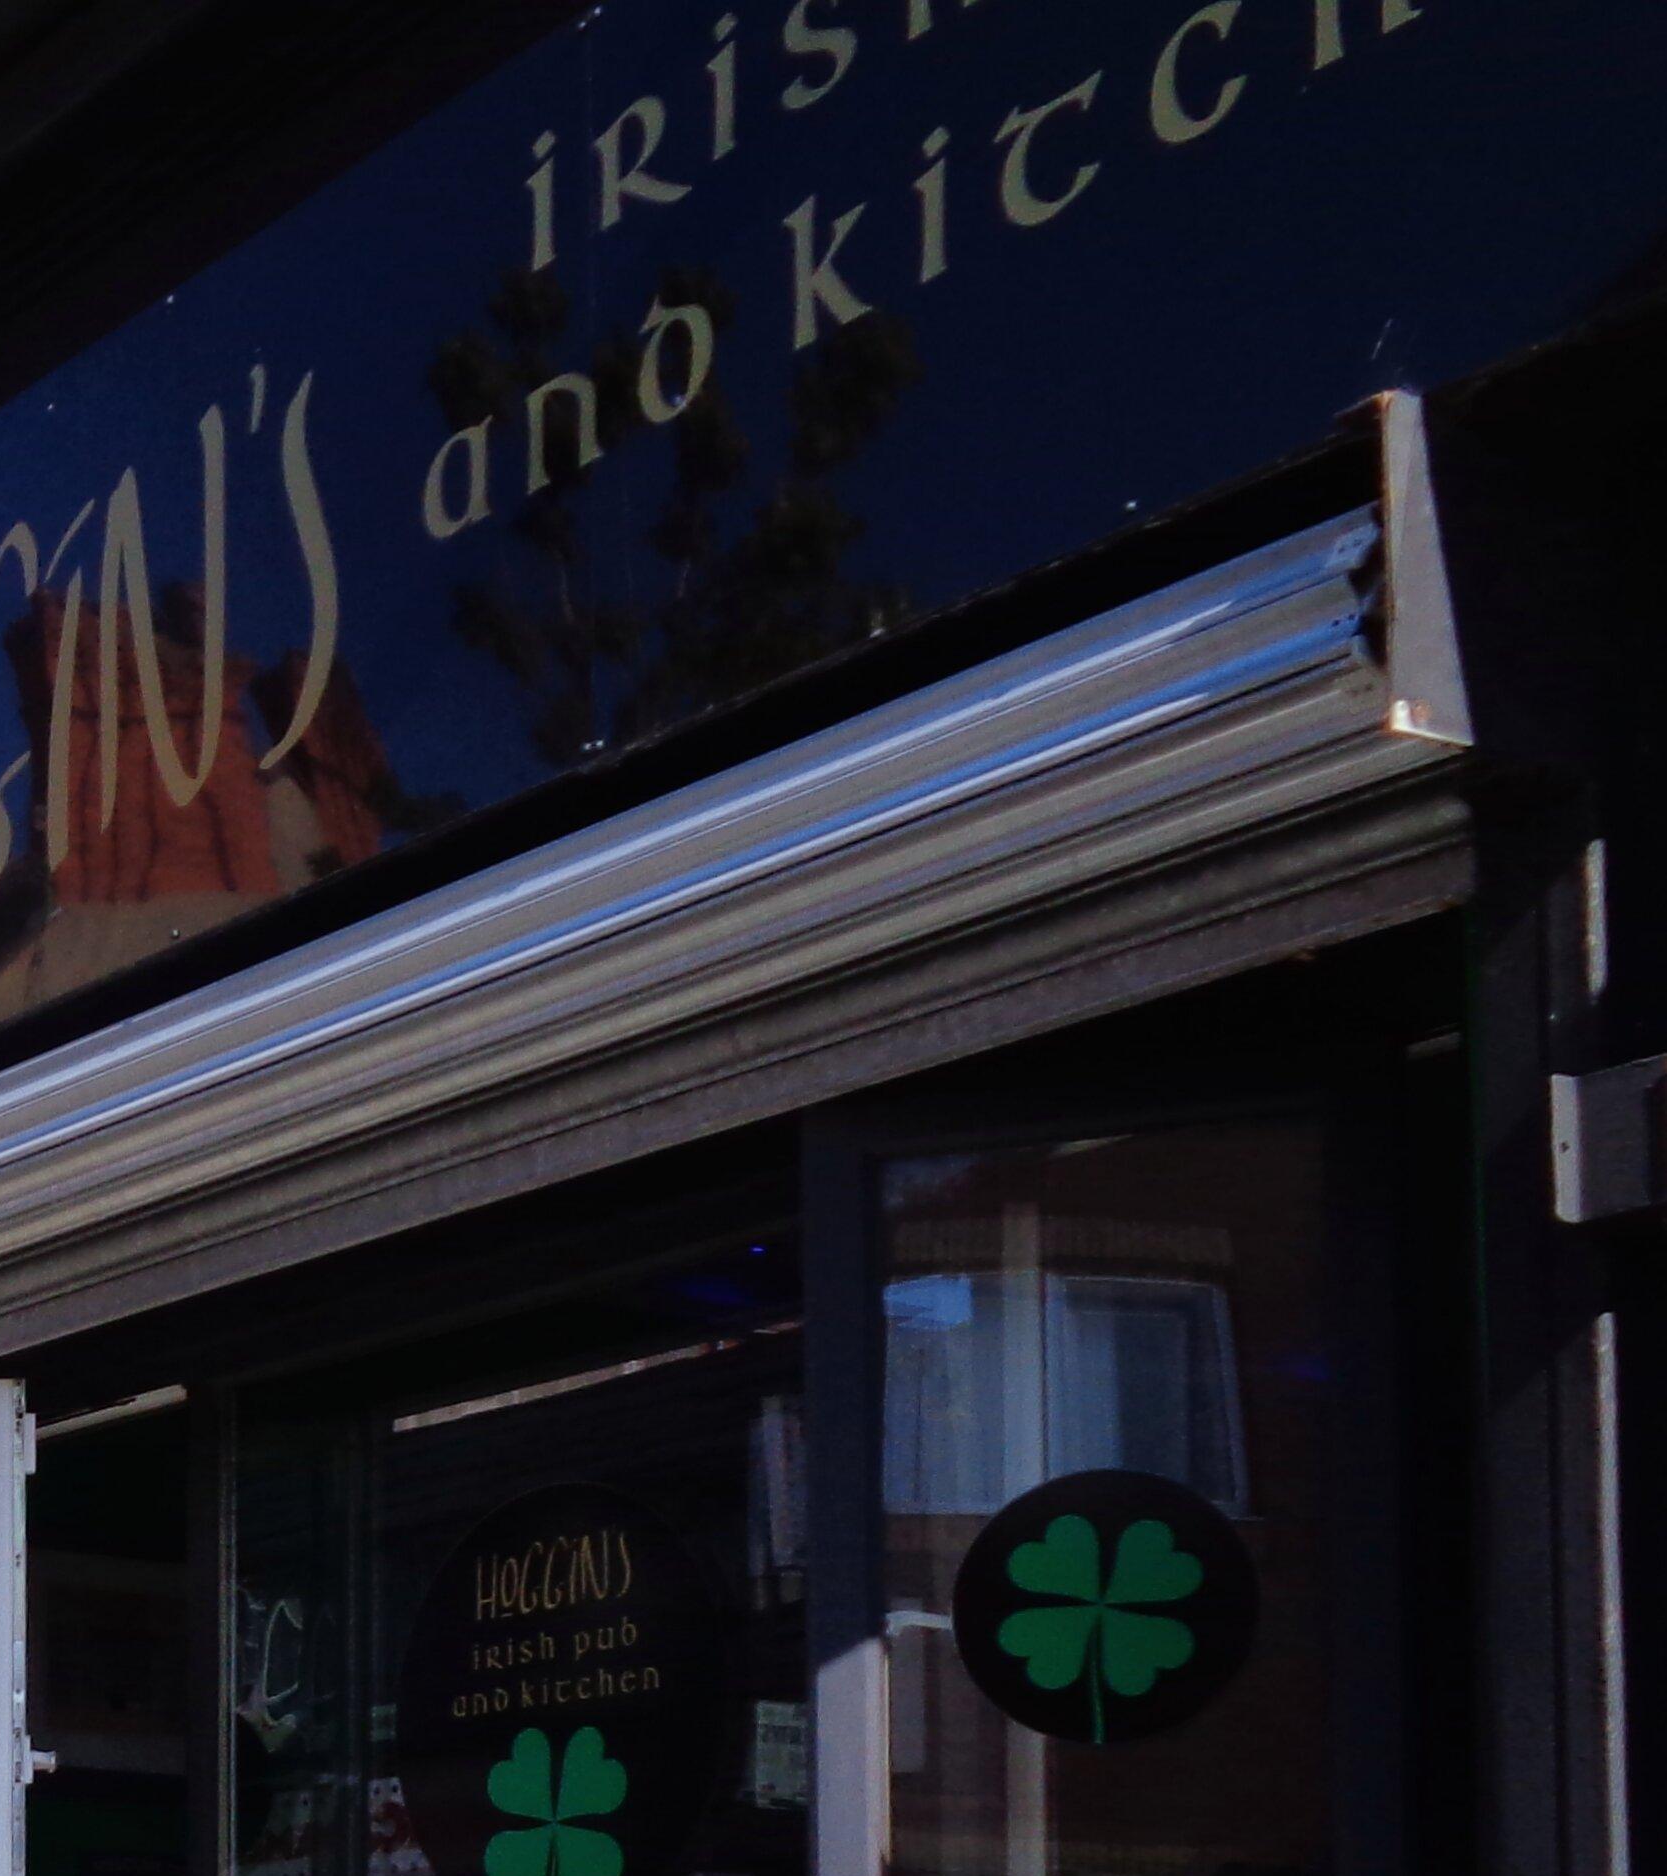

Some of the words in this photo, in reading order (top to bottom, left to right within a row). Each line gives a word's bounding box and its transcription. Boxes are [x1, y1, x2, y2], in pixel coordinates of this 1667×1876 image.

[571, 1615, 638, 1663] pub
[449, 1686, 512, 1718] and
[519, 1664, 661, 1710] kitchen
